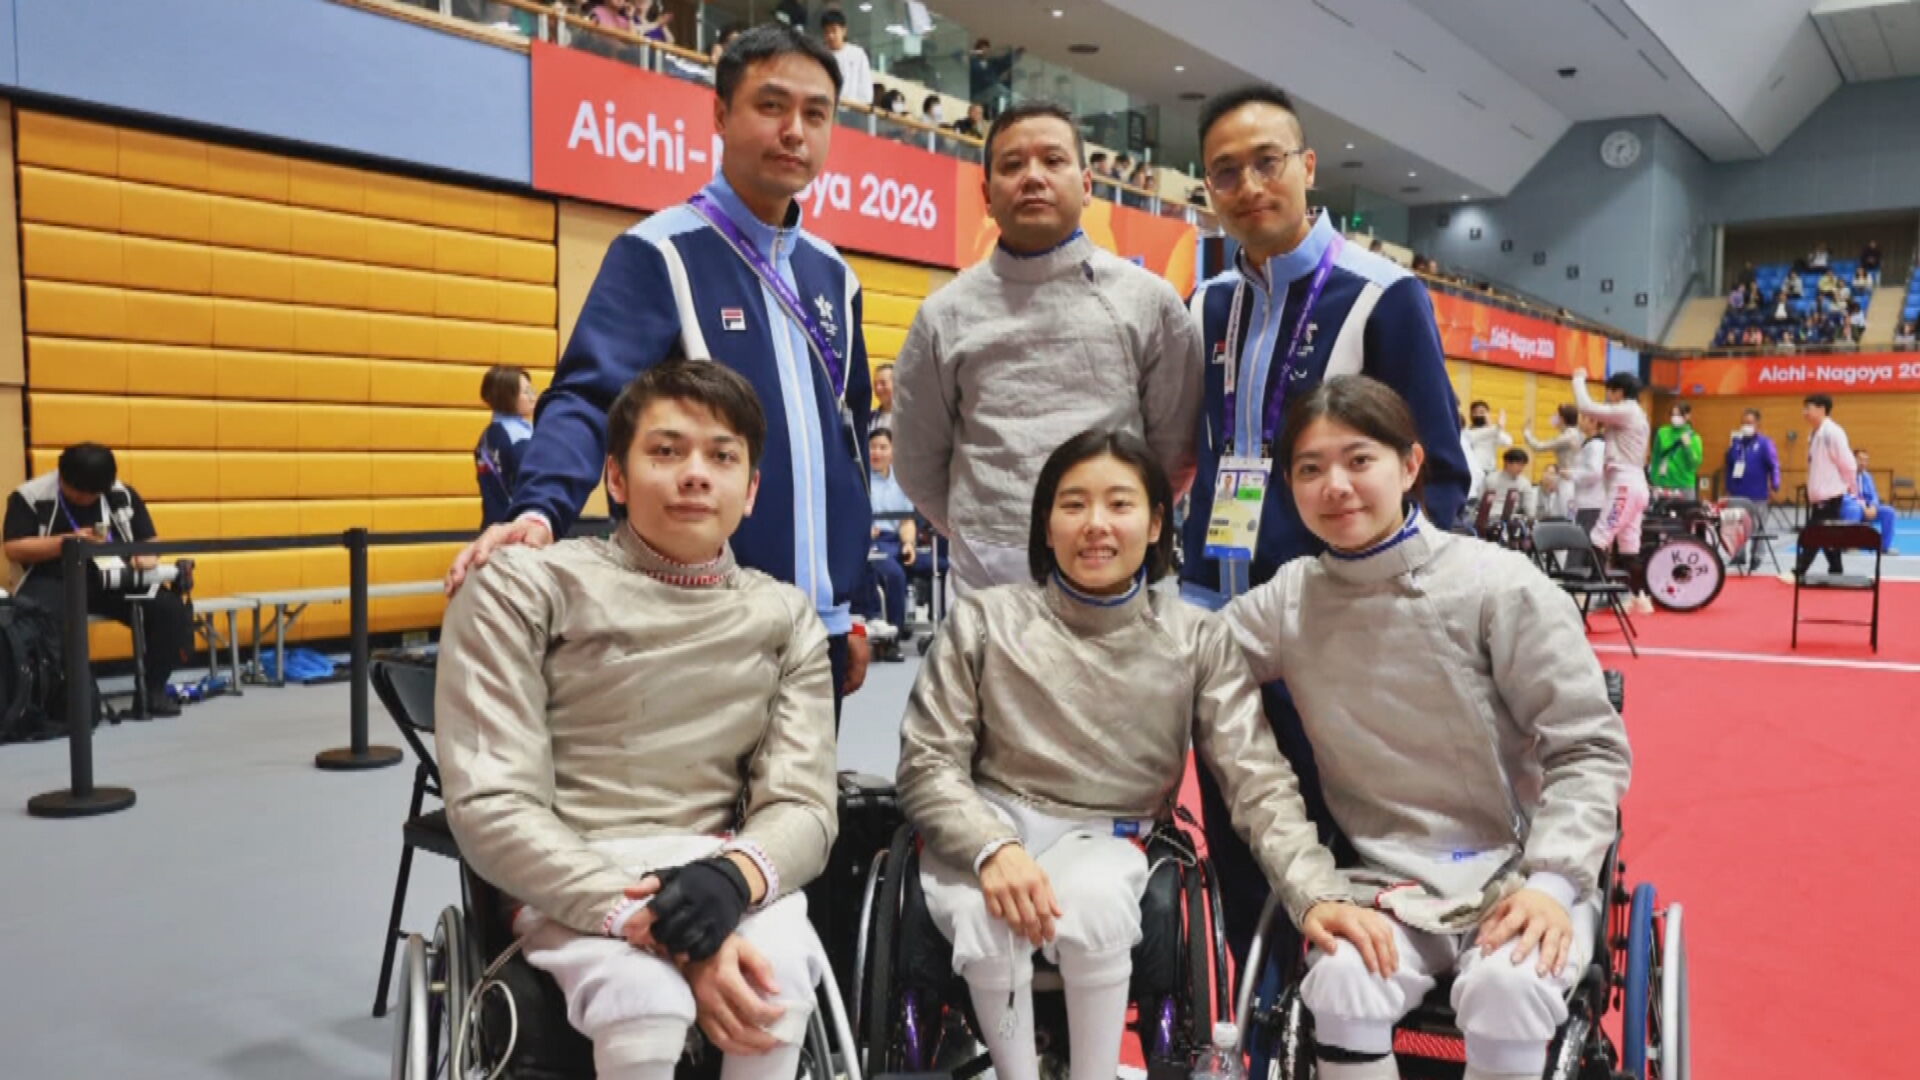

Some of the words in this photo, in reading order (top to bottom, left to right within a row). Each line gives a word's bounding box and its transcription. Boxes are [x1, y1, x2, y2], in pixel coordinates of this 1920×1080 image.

[859, 172, 938, 230] 2026
[1758, 364, 1893, 385] Aichi-Nagoya
[1671, 550, 1709, 577] KOR
